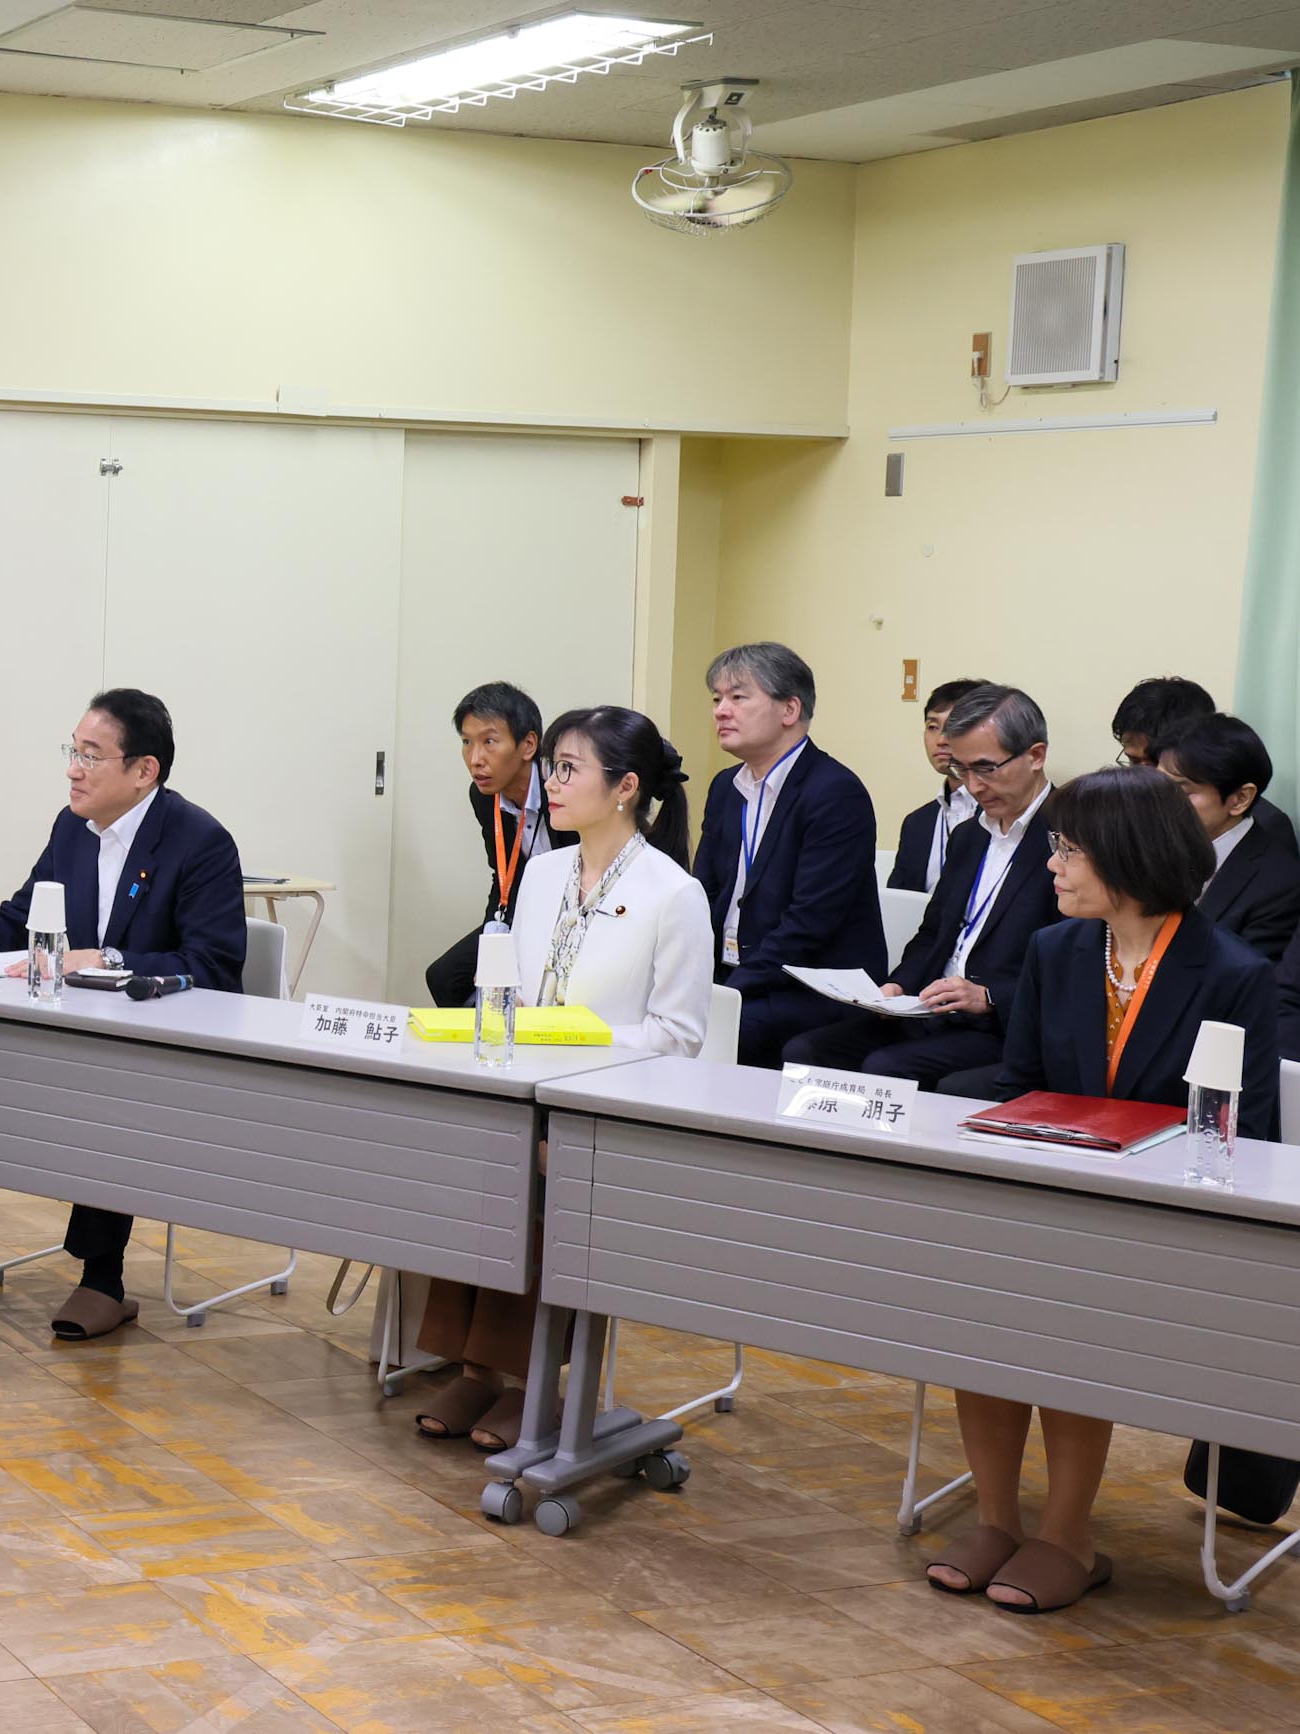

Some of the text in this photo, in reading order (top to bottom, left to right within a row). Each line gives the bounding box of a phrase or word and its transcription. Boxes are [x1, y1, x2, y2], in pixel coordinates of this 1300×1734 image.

[315, 1014, 400, 1043] 加藤 鮎子
[875, 1088, 893, 1099] 局長
[861, 1099, 906, 1123] 朋子
